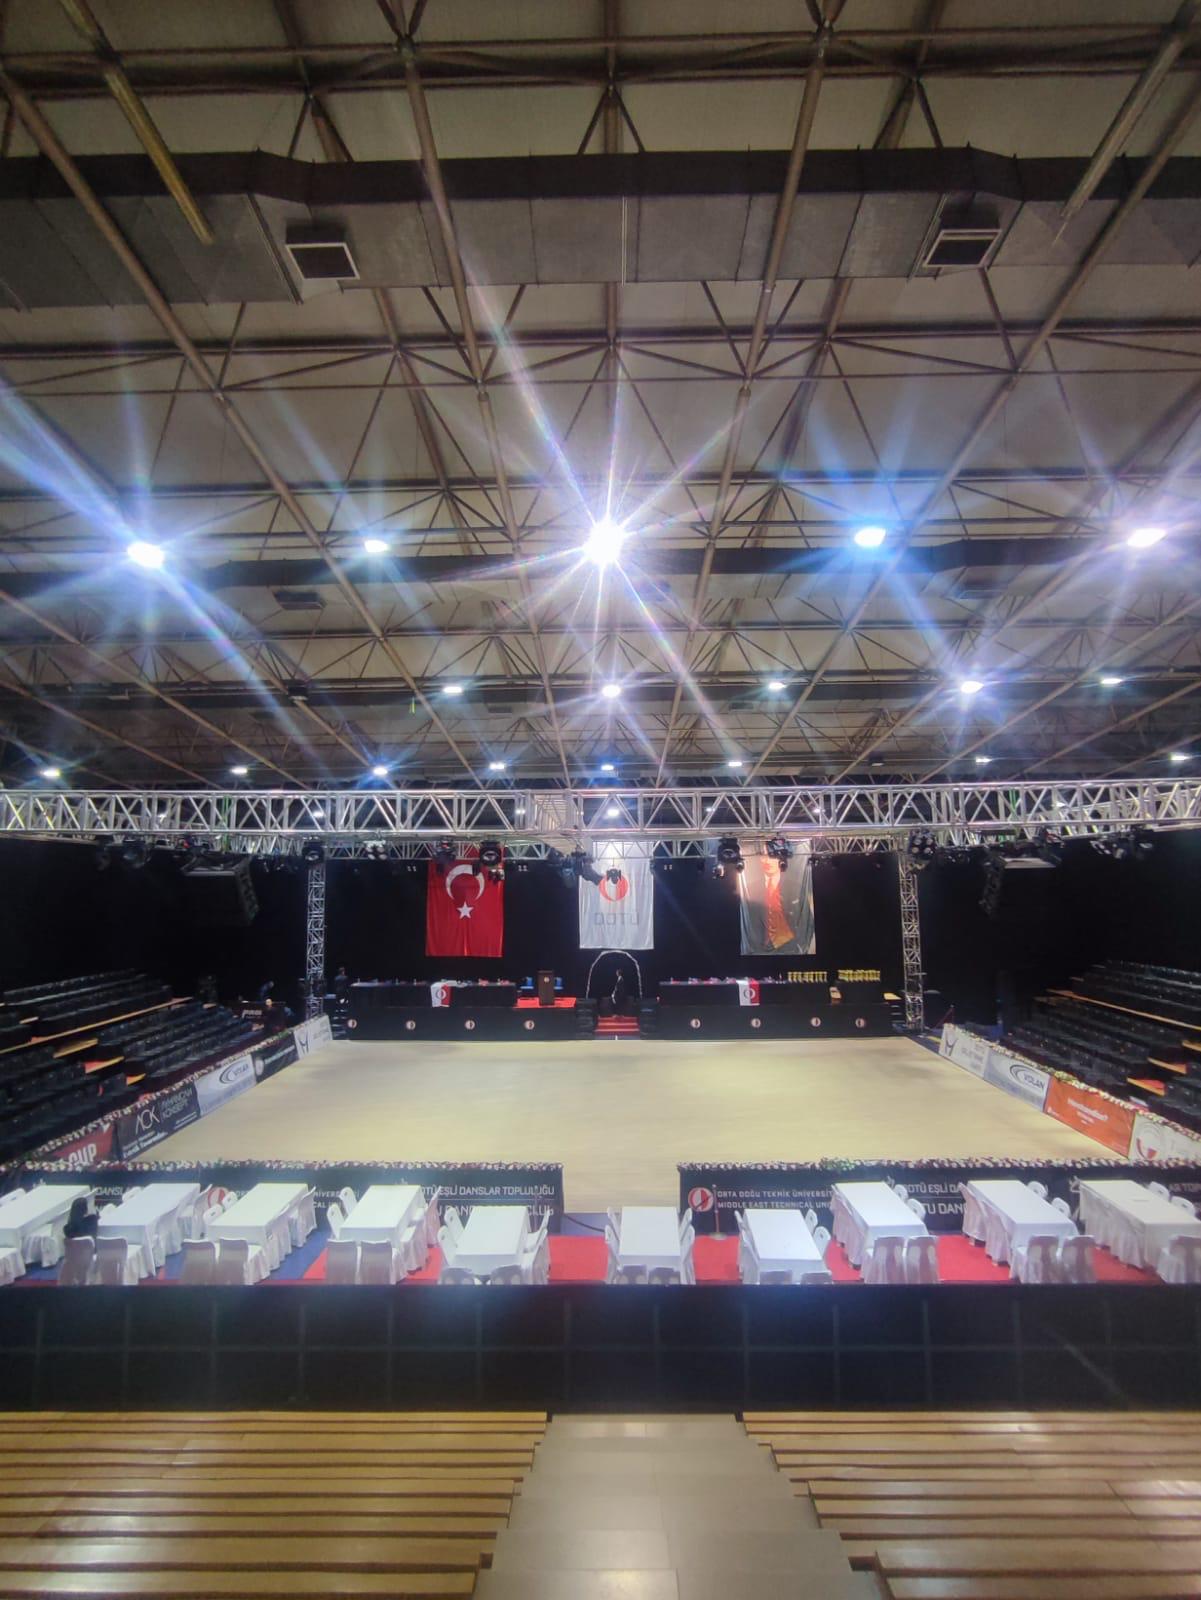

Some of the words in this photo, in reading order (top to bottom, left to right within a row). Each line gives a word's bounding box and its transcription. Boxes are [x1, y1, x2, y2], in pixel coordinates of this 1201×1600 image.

[459, 1186, 501, 1196] DANSLAR
[717, 1190, 737, 1199] ORTA
[739, 1188, 761, 1199] DOĞU
[763, 1189, 790, 1198] TEKNİK
[717, 1201, 747, 1209] MIDDLE
[748, 1201, 768, 1209] EAST
[771, 1201, 813, 1209] TECHNICAL
